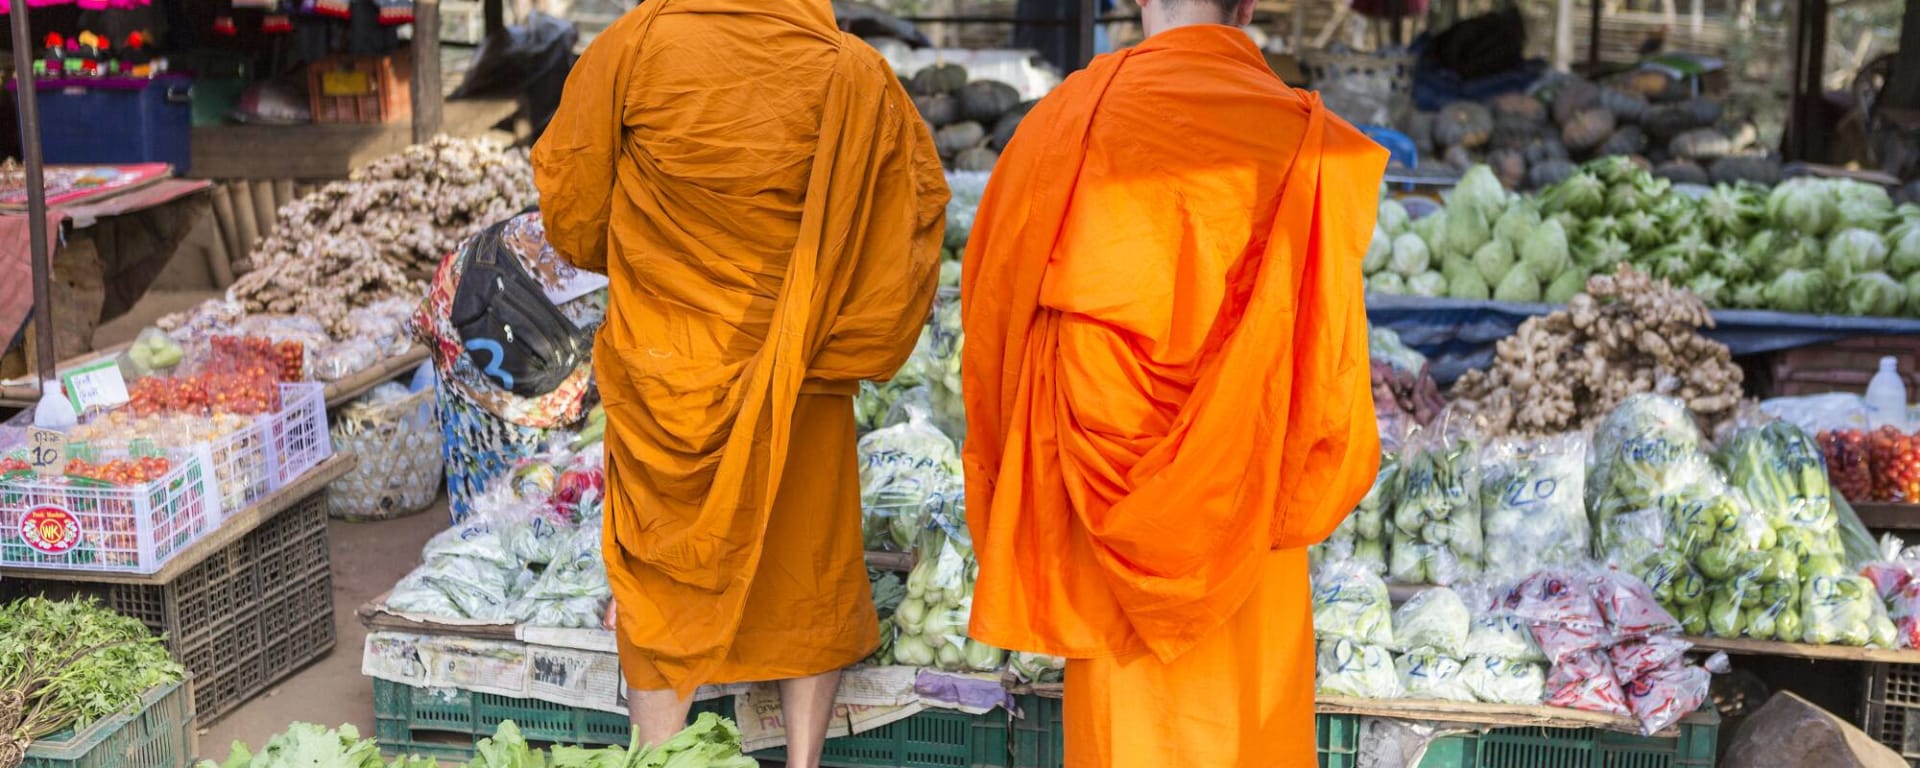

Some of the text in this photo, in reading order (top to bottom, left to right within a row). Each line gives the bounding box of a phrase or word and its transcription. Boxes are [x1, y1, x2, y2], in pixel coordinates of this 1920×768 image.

[32, 446, 58, 466] 10
[1505, 478, 1557, 507] 20
[41, 524, 61, 540] WK
